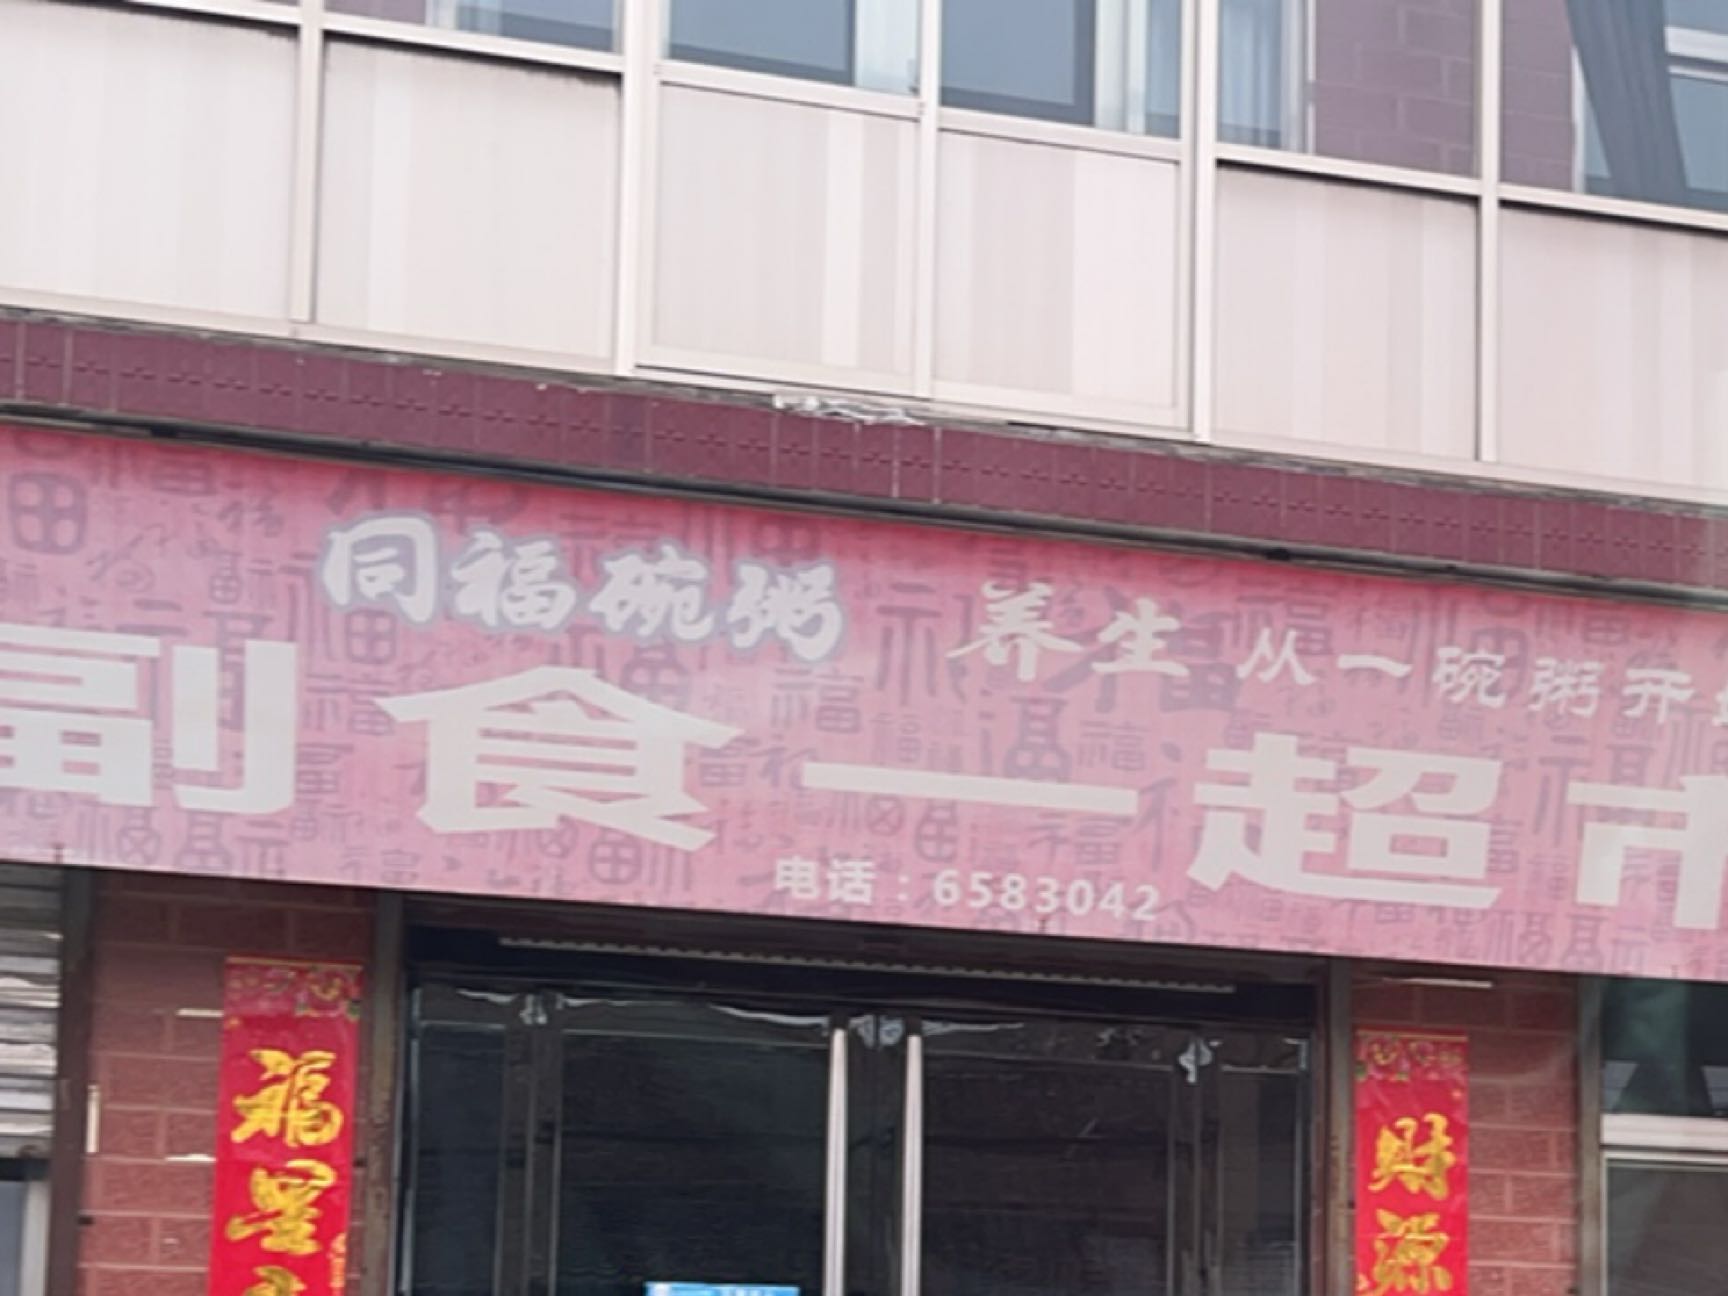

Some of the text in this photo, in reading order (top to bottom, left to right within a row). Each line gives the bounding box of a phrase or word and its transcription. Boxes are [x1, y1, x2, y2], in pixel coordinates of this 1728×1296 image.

[318, 512, 848, 662] 同福碗粥
[948, 581, 1190, 681] 养生
